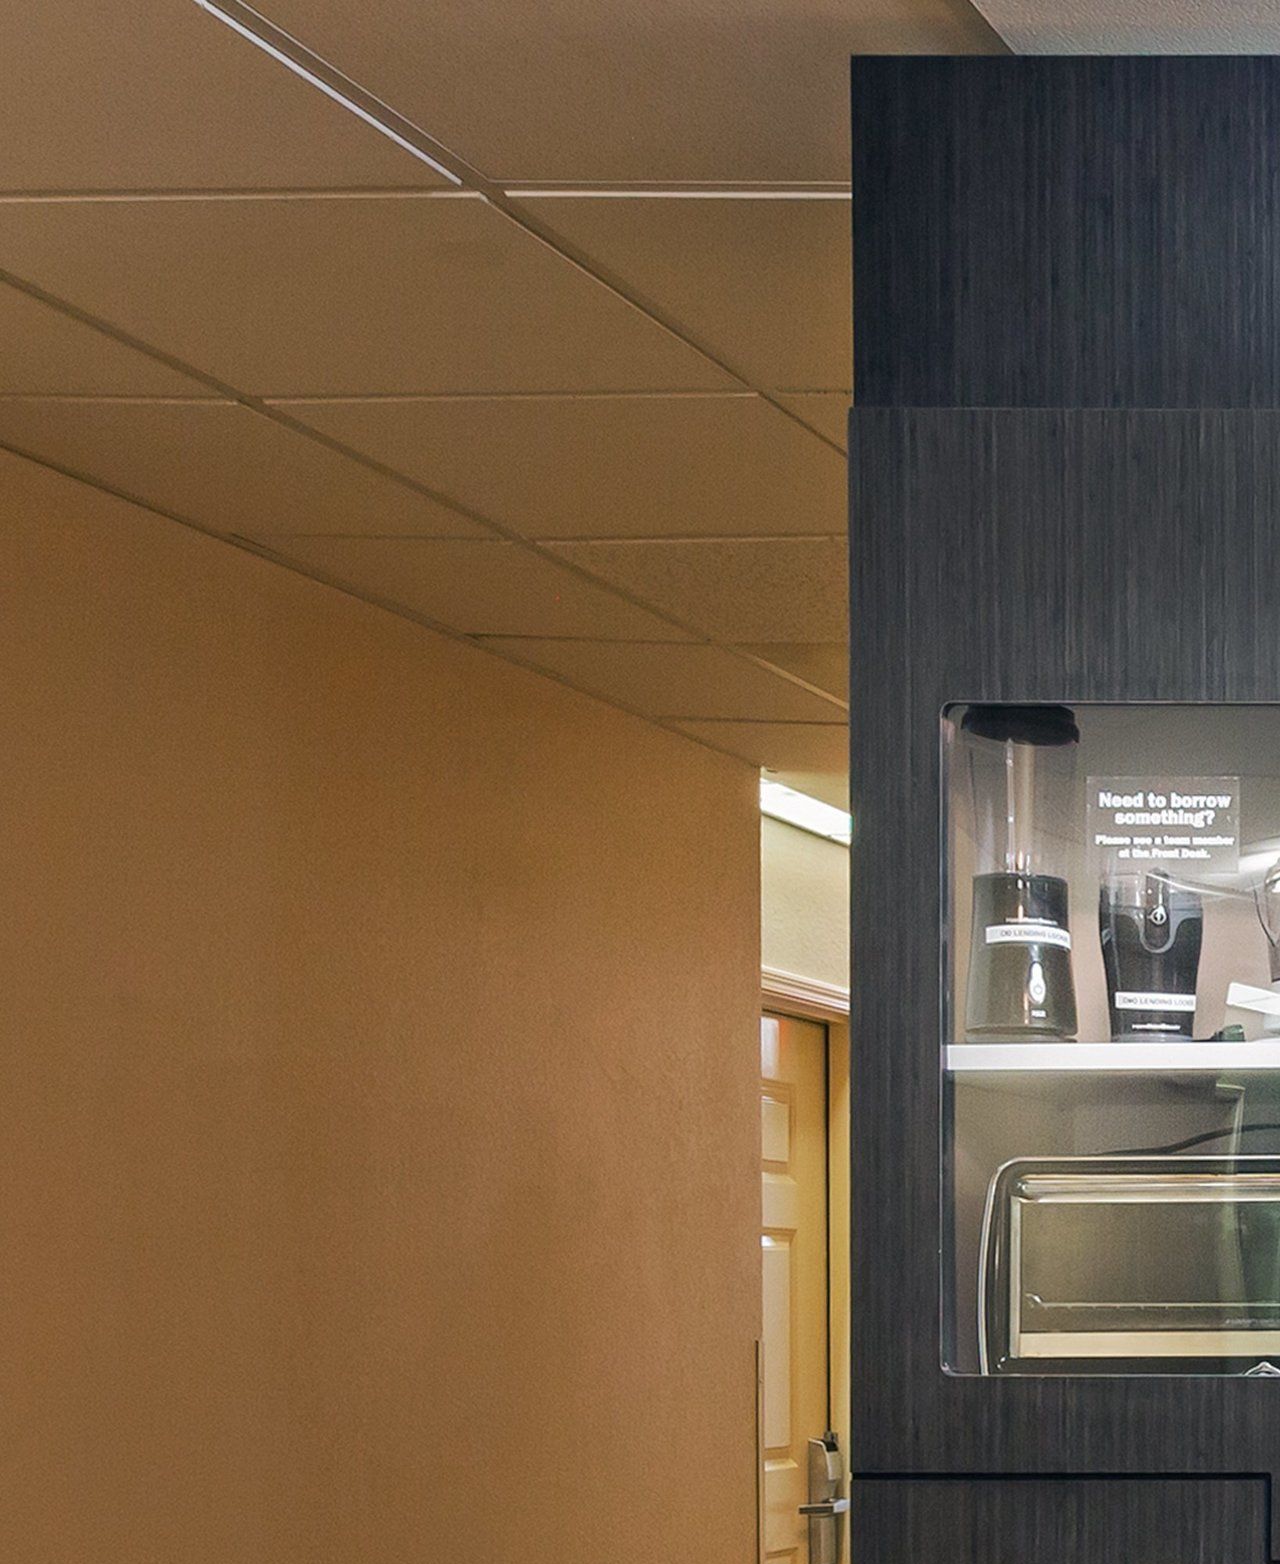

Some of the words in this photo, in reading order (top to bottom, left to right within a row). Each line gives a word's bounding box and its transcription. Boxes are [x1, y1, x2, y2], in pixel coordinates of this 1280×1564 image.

[1098, 791, 1144, 808] Need
[1147, 792, 1167, 808] to
[1170, 791, 1231, 808] borrow
[1114, 809, 1216, 828] something?
[1095, 834, 1131, 846] Please
[1133, 836, 1152, 846] see
[1154, 837, 1162, 846] a
[1163, 835, 1190, 846] team
[1192, 835, 1235, 846] member
[1118, 849, 1130, 859] at
[1132, 848, 1150, 859] the
[1152, 849, 1179, 859] Front
[1181, 849, 1211, 859] Desk.
